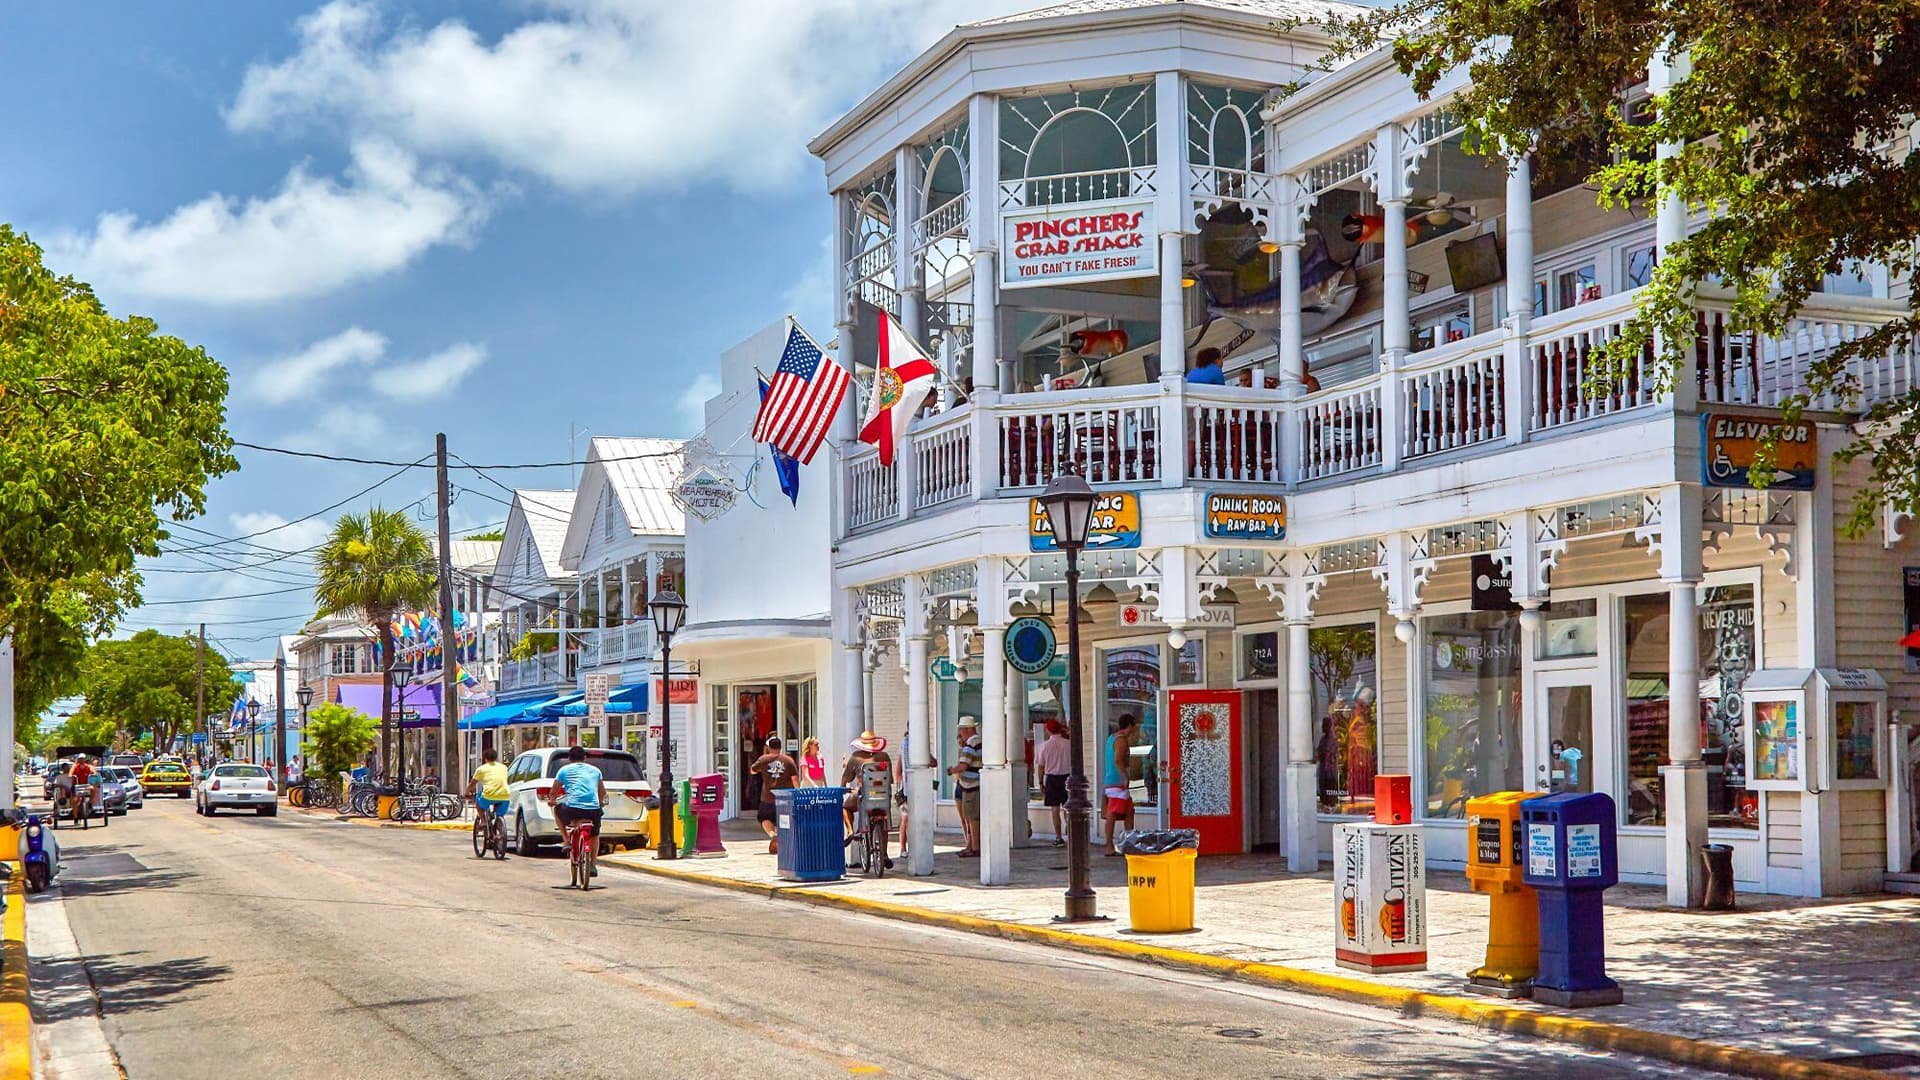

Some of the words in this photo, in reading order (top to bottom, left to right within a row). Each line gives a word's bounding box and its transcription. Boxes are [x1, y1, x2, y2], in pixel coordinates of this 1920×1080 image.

[1015, 211, 1144, 243] PINCHERS
[1015, 239, 1070, 259] CRAB
[1072, 233, 1144, 252] SHACK
[1211, 497, 1248, 514] DINING
[1252, 499, 1282, 514] ROOM
[1227, 518, 1247, 531] RAW
[1248, 520, 1266, 532] BAR
[1703, 609, 1736, 630] NEVER
[1455, 639, 1507, 665] sunglass
[670, 680, 697, 692] LIRT
[1342, 834, 1356, 902] CITIZEN
[1384, 834, 1405, 906] CITIZEN
